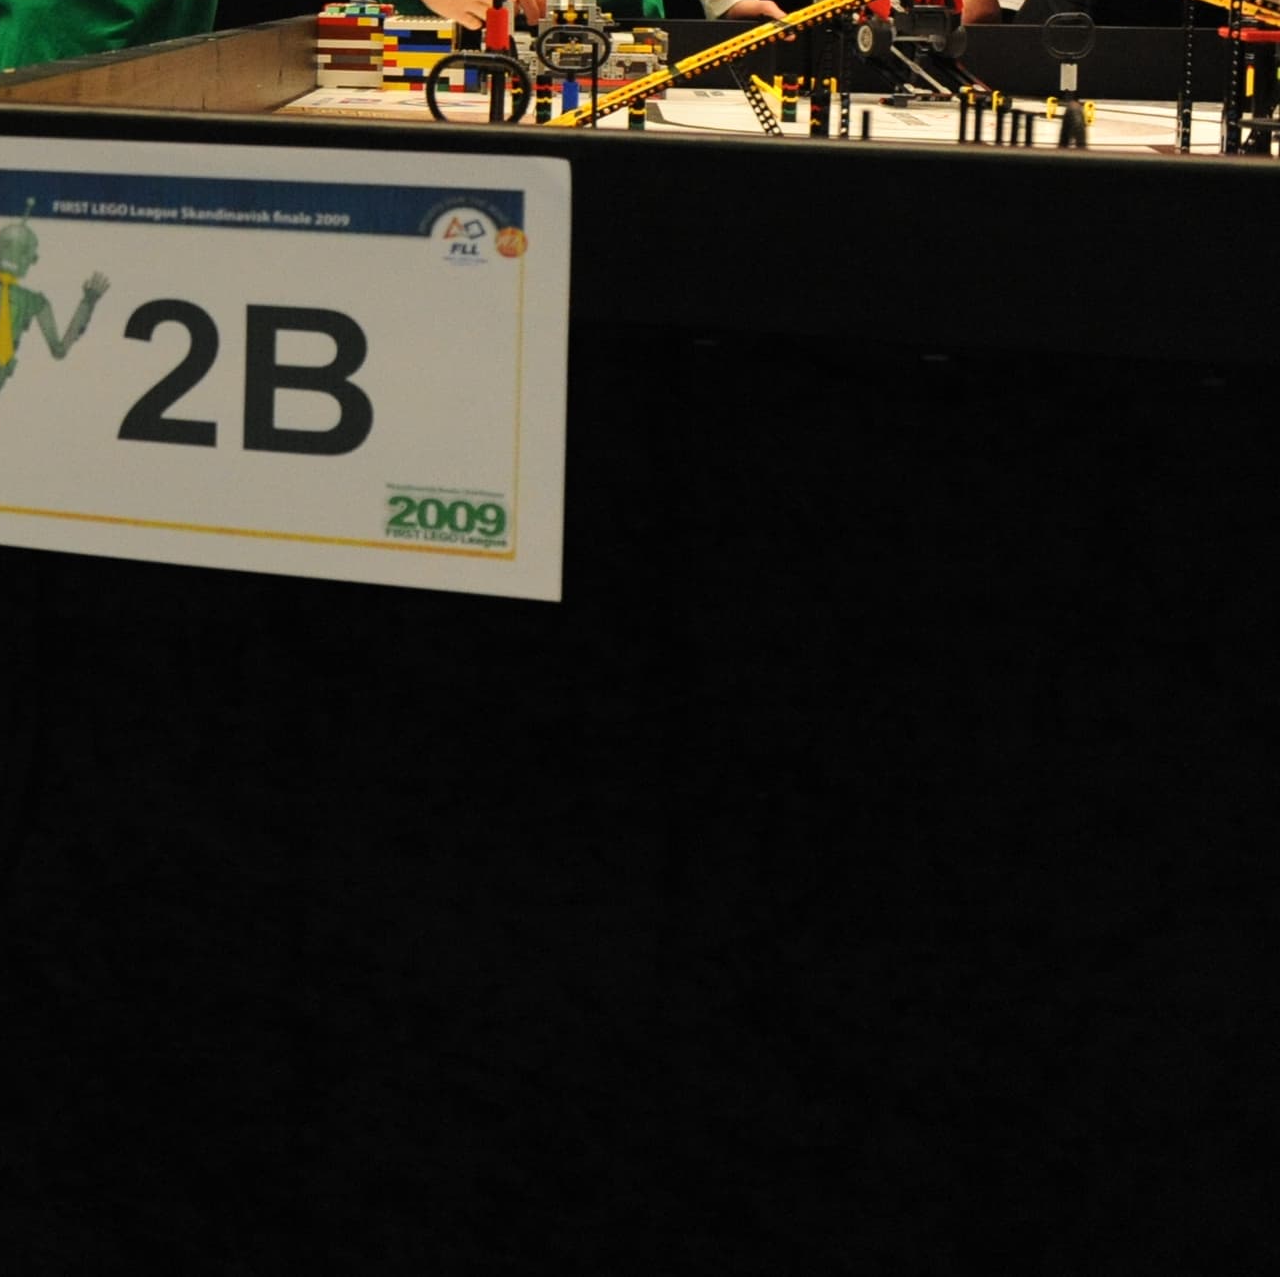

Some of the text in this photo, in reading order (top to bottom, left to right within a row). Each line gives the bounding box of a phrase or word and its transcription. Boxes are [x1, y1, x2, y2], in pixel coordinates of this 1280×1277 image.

[52, 200, 351, 227] FIRST LEGO League Skandinavisk finale 2009
[451, 242, 480, 255] FLL
[117, 298, 374, 456] 2B
[386, 495, 507, 538] 2009
